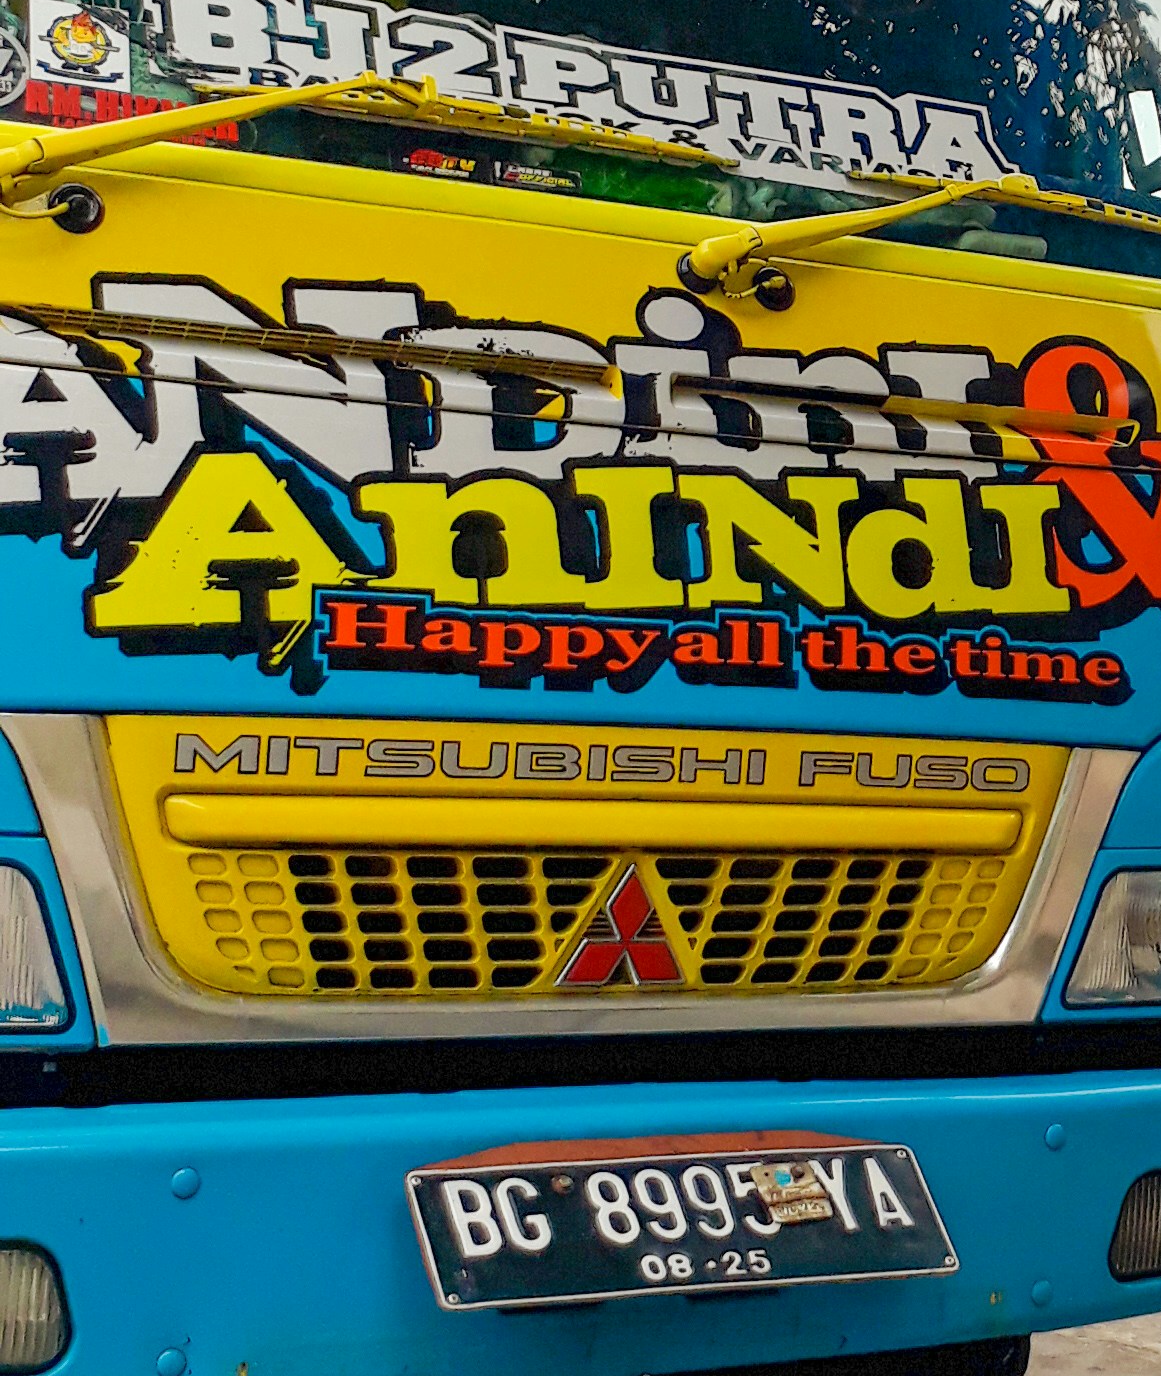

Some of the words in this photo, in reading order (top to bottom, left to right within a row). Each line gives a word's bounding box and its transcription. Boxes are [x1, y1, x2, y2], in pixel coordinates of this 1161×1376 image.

[326, 602, 661, 672] Happy
[673, 620, 785, 668] all
[802, 626, 938, 674] the
[950, 636, 1122, 687] time
[174, 733, 767, 786] MITSUBISHI
[798, 751, 1031, 793] FUSO
[442, 1177, 553, 1259] BG
[585, 1161, 781, 1246] 8995
[811, 1157, 916, 1234] YA
